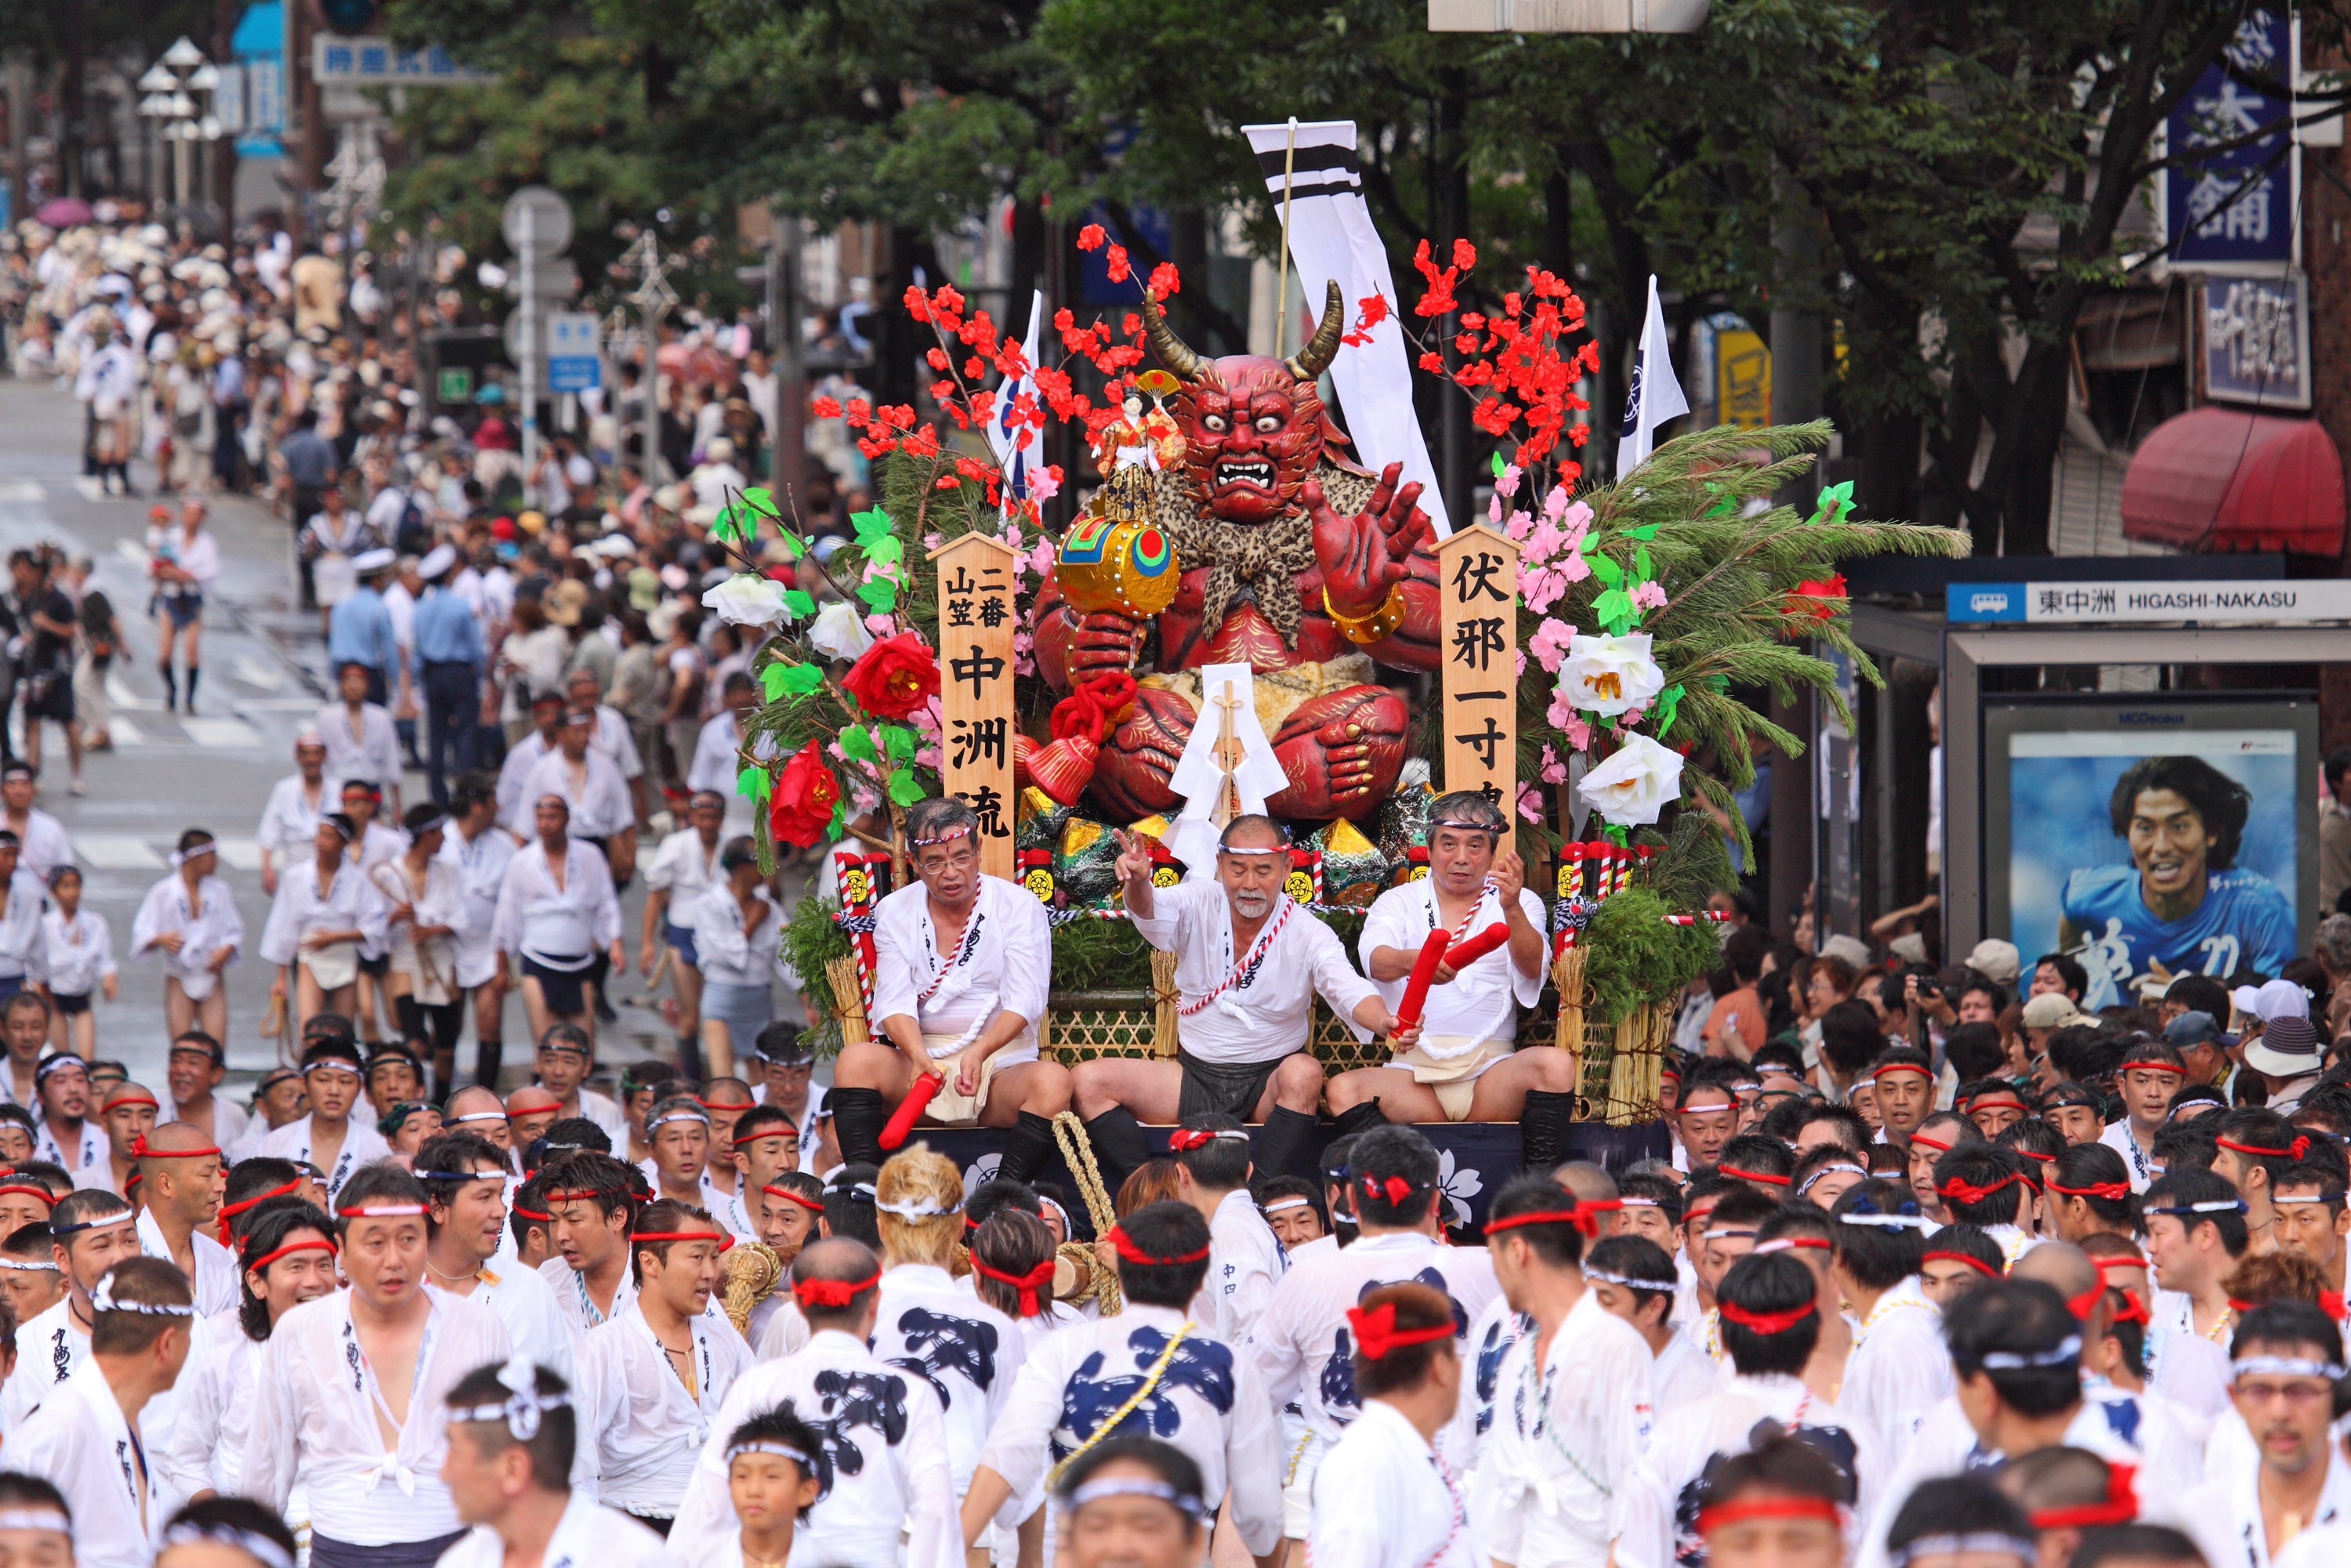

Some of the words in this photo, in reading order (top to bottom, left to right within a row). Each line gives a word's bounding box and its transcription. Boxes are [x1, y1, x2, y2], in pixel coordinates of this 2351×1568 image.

[945, 566, 976, 628] 山笠
[977, 567, 1009, 628] 二番
[2039, 588, 2117, 615] 東中洲
[2128, 591, 2297, 609] HIGASHI-NAKASU
[949, 644, 1011, 838] 中洲流
[2118, 712, 2185, 724] MCDecaux
